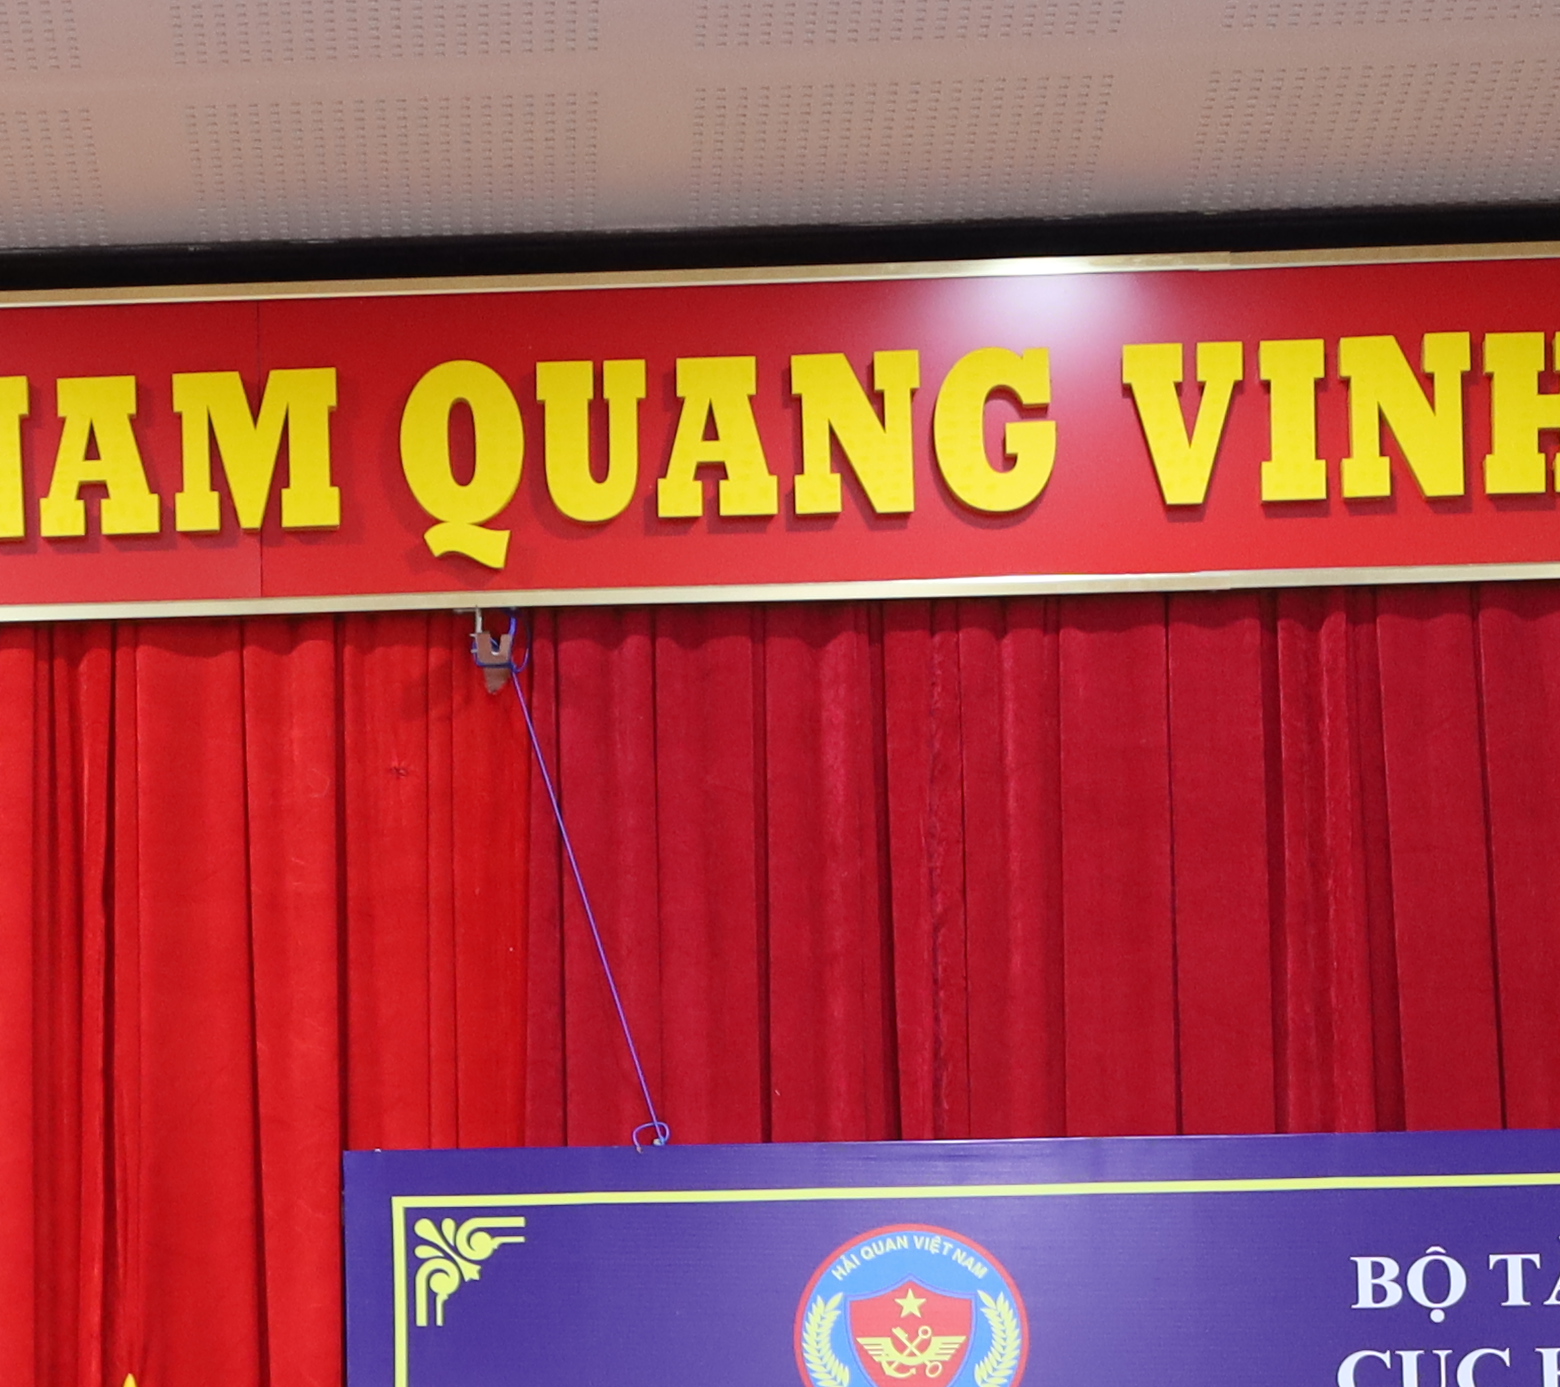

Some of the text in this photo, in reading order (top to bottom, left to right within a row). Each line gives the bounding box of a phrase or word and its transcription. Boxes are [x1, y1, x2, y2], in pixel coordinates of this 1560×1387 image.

[400, 346, 1057, 569] QUANG
[831, 1235, 988, 1281] HẢI QUAN VIỆT NAM
[1350, 1246, 1467, 1323] BỘ
